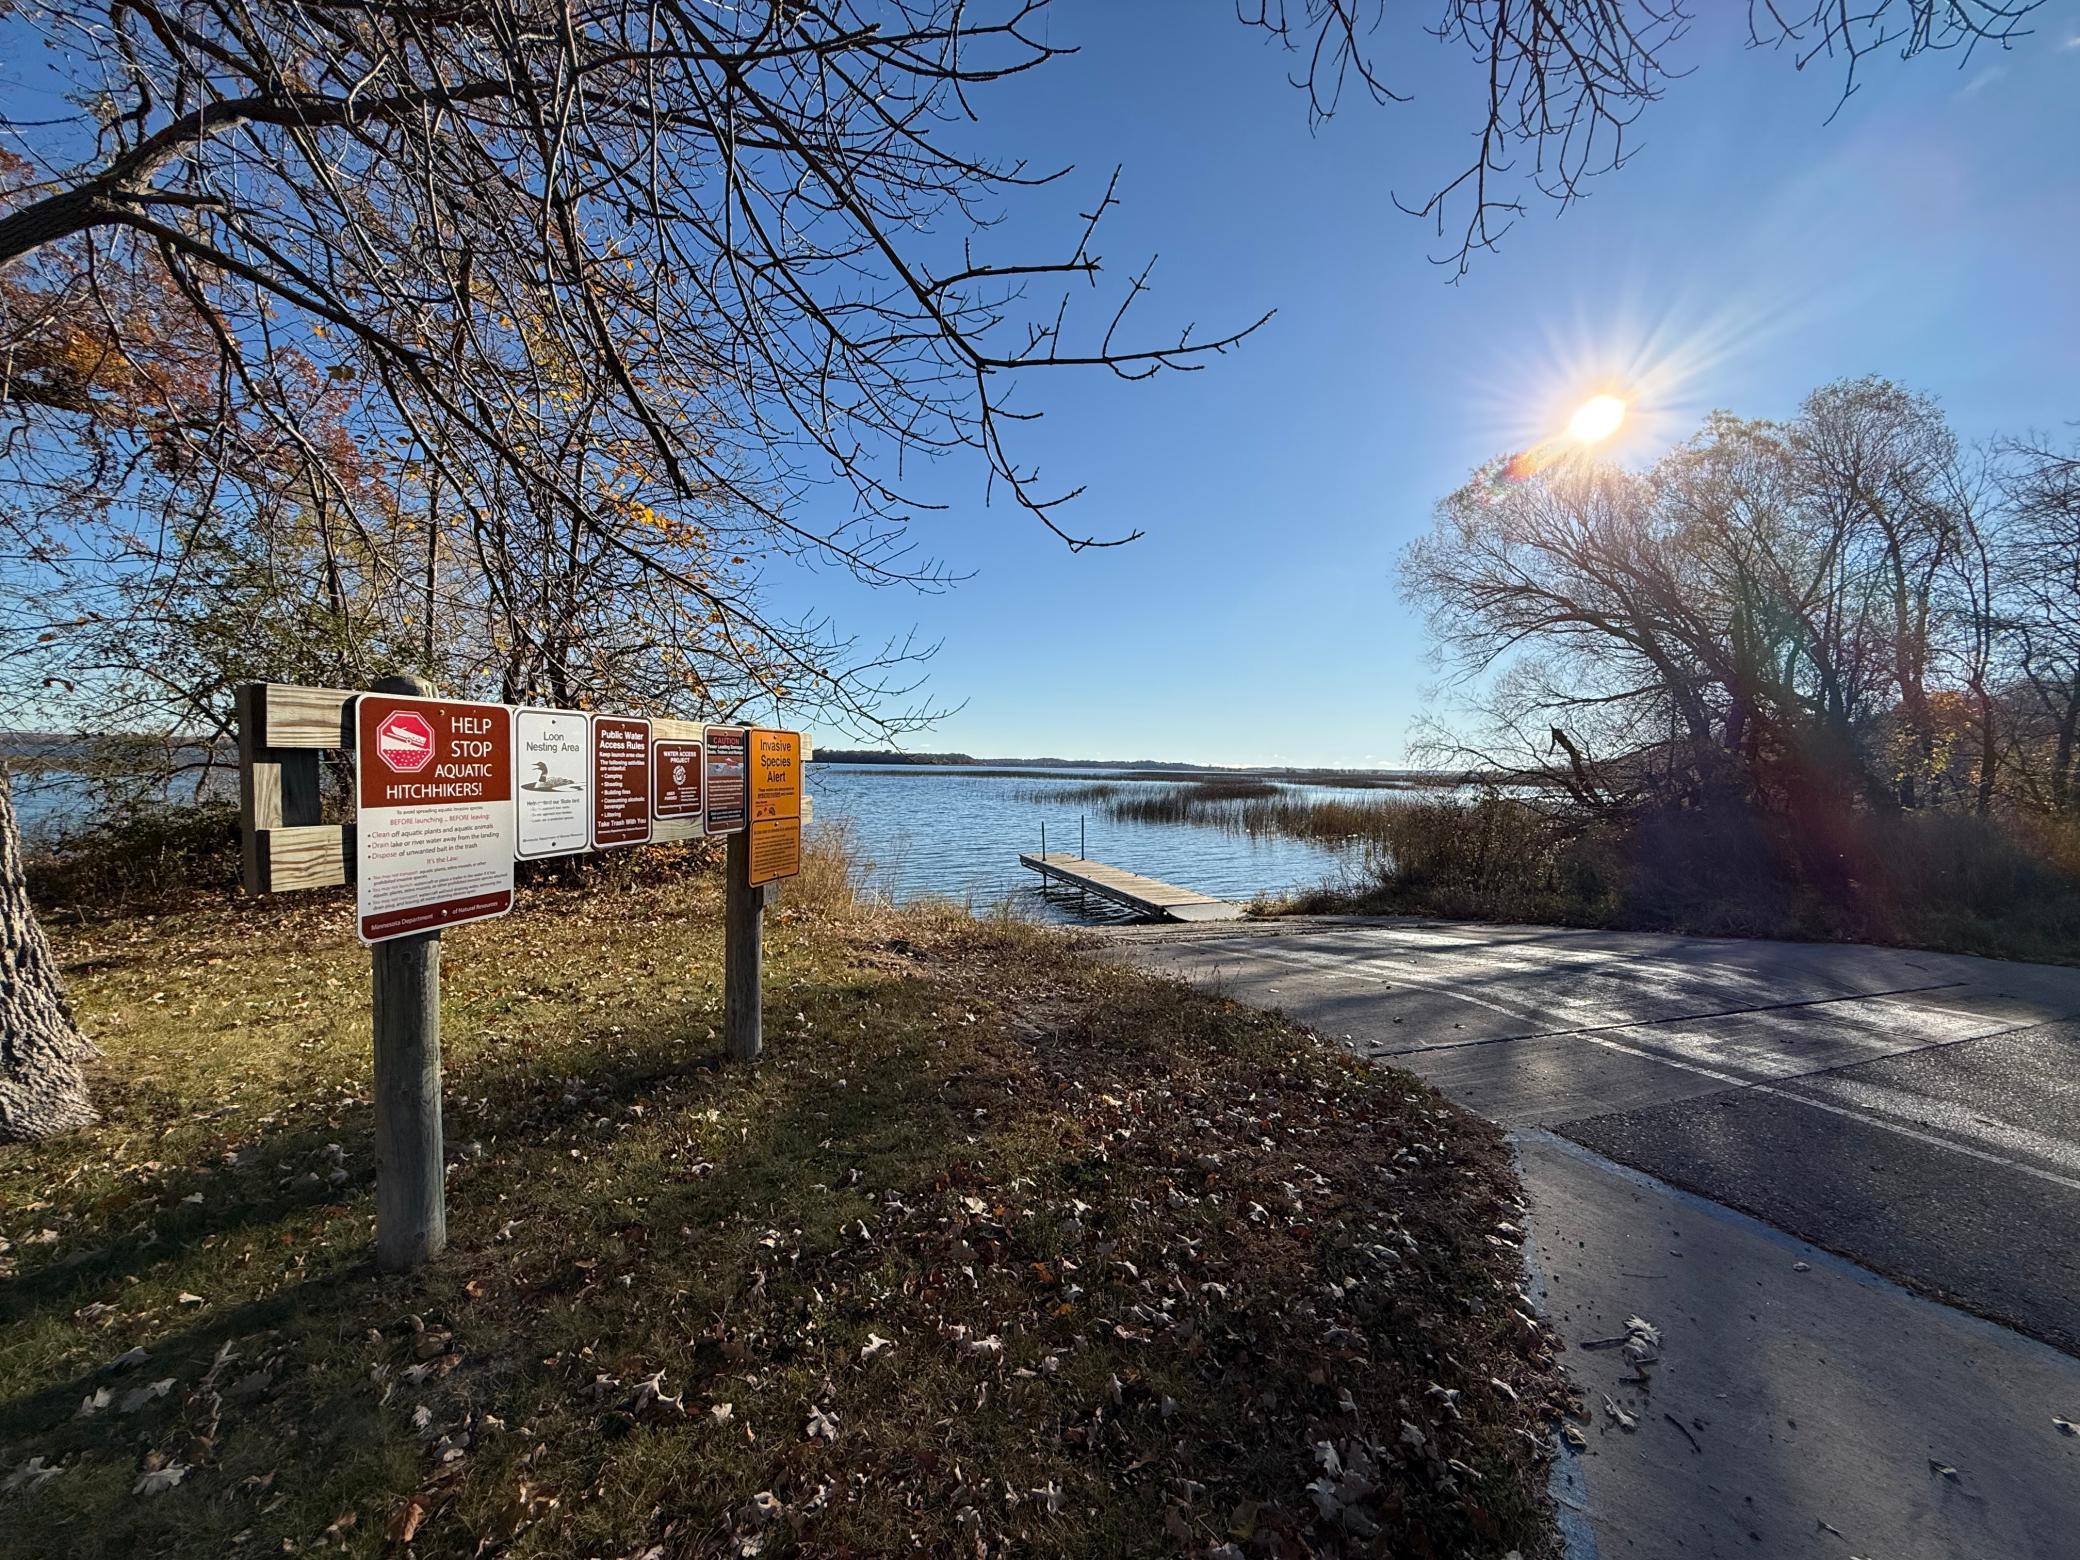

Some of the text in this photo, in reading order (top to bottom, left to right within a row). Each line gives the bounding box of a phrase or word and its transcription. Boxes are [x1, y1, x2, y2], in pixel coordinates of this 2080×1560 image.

[452, 717, 492, 734] HELP
[544, 732, 564, 740] Loon
[602, 730, 643, 739] Public Water
[451, 741, 492, 758] STOP
[527, 742, 579, 753] Nesting Area
[600, 740, 625, 749] Access
[761, 739, 791, 751] Invasive
[761, 755, 790, 769] Species
[435, 764, 492, 778] AQUATIC
[767, 771, 786, 782] Alert
[387, 783, 482, 799] HITCHHIKERS!
[424, 828, 441, 836] plants
[372, 852, 397, 860] Dispose
[407, 847, 435, 855] unwanted
[371, 920, 400, 930] Minnesota
[402, 914, 433, 924] Department
[476, 902, 498, 910] Resources
